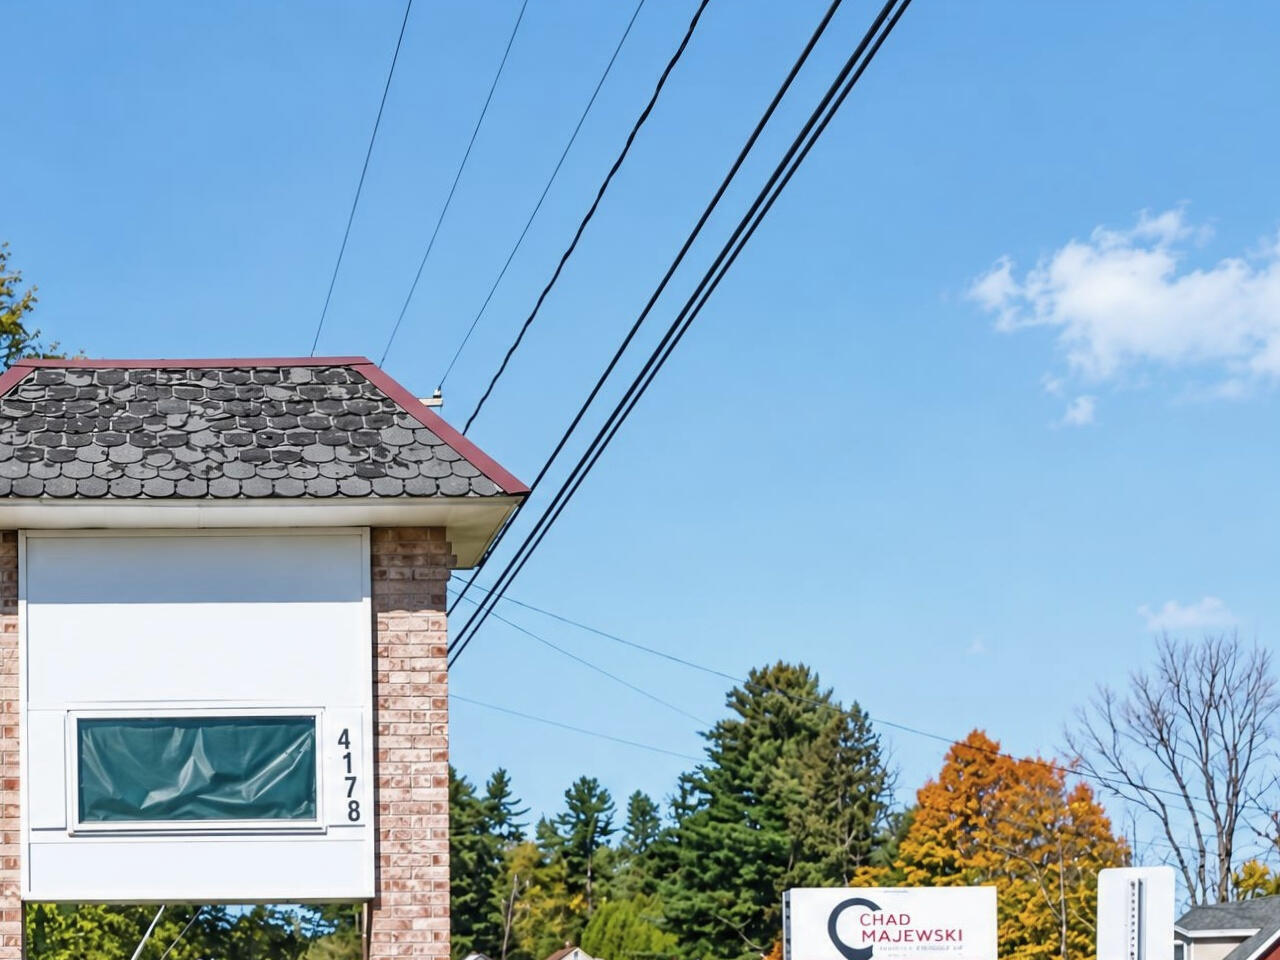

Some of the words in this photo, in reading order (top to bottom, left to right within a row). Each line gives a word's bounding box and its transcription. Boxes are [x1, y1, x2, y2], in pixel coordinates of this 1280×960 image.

[337, 728, 361, 822] 4178
[859, 913, 911, 926] CHAD
[861, 929, 963, 943] MAJEWSKI
